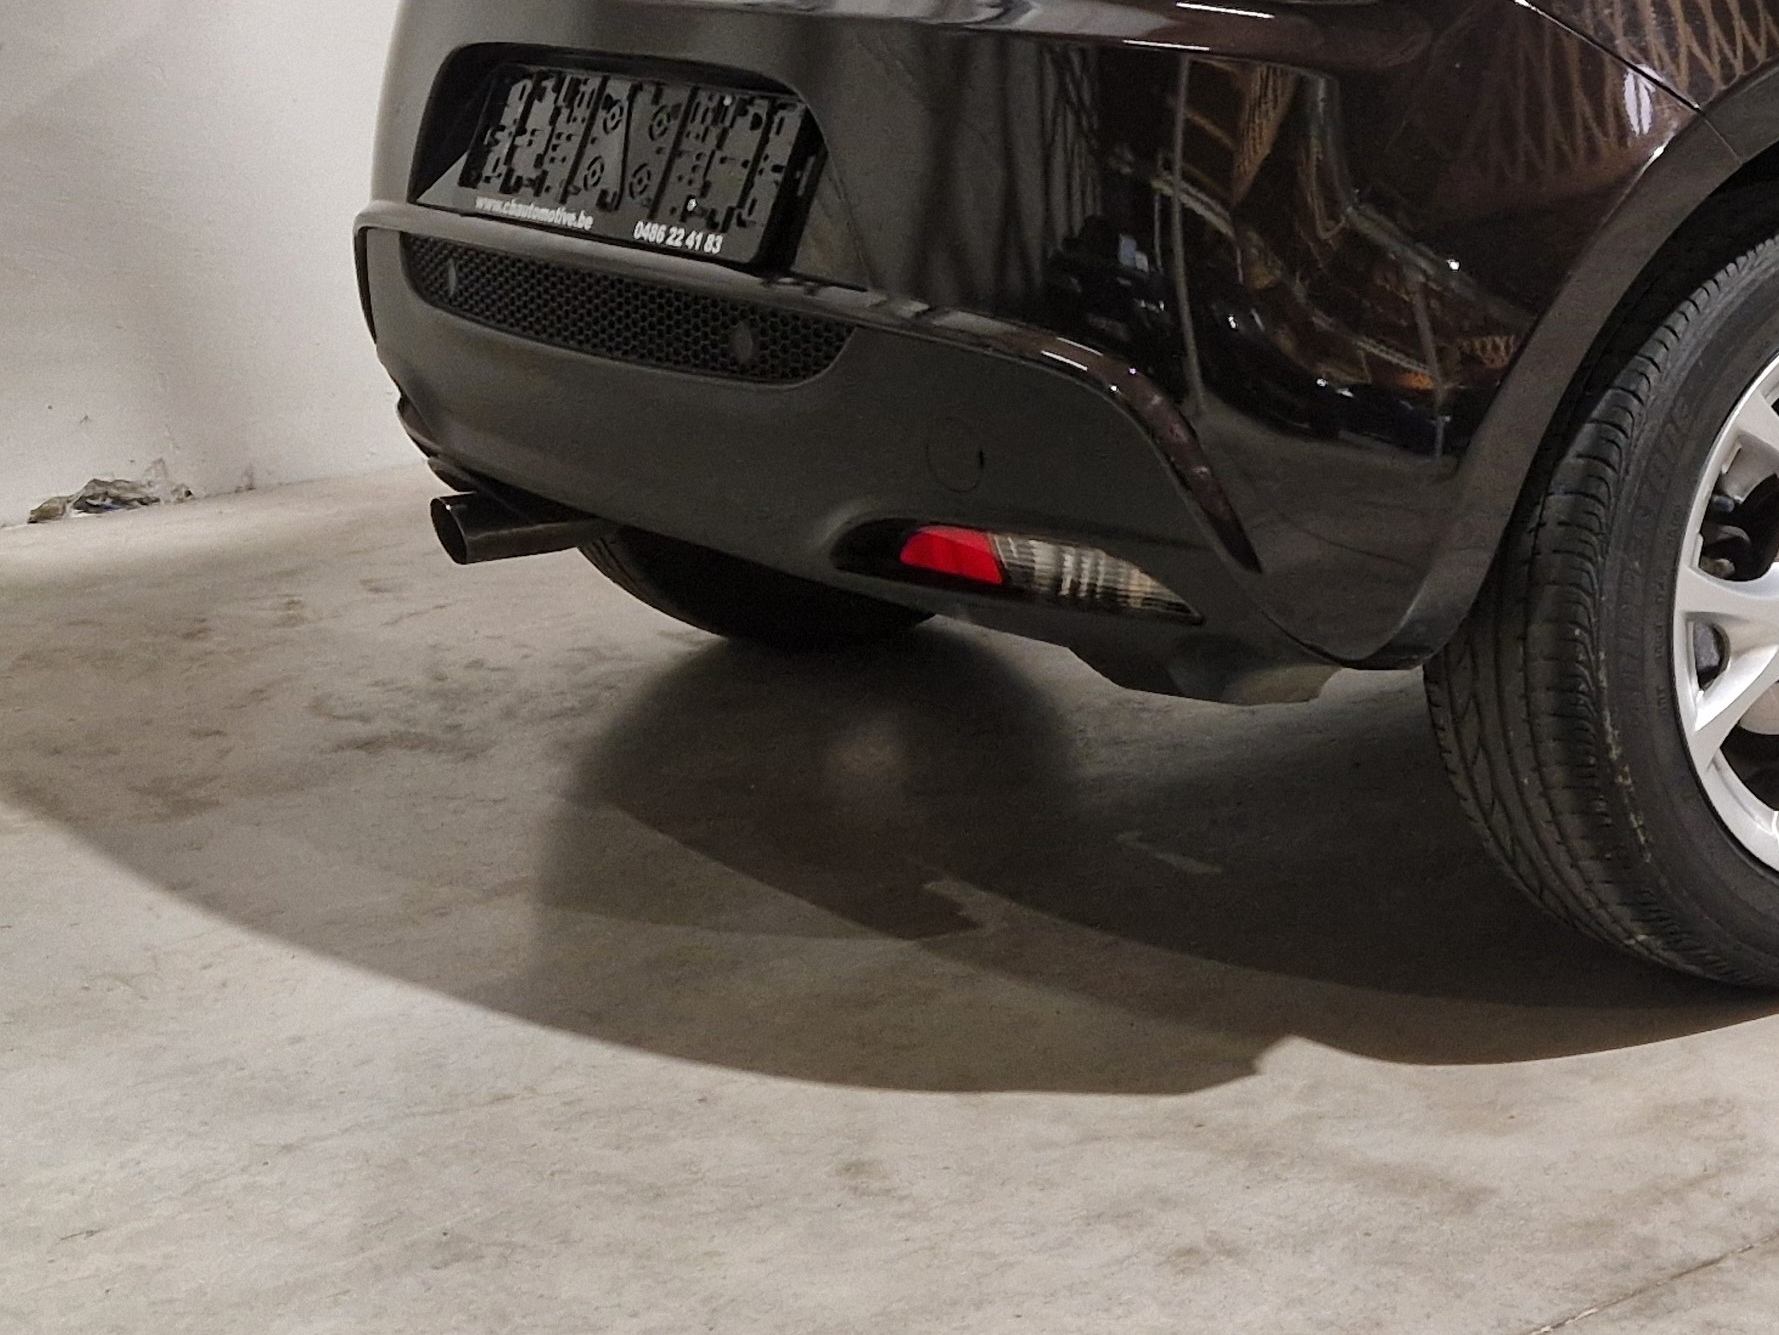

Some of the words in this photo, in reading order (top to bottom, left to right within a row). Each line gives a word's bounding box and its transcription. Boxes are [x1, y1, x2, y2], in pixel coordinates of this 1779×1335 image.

[633, 220, 667, 244] 0486
[666, 226, 685, 247] 22
[685, 230, 703, 251] 41
[703, 233, 723, 254] 83
